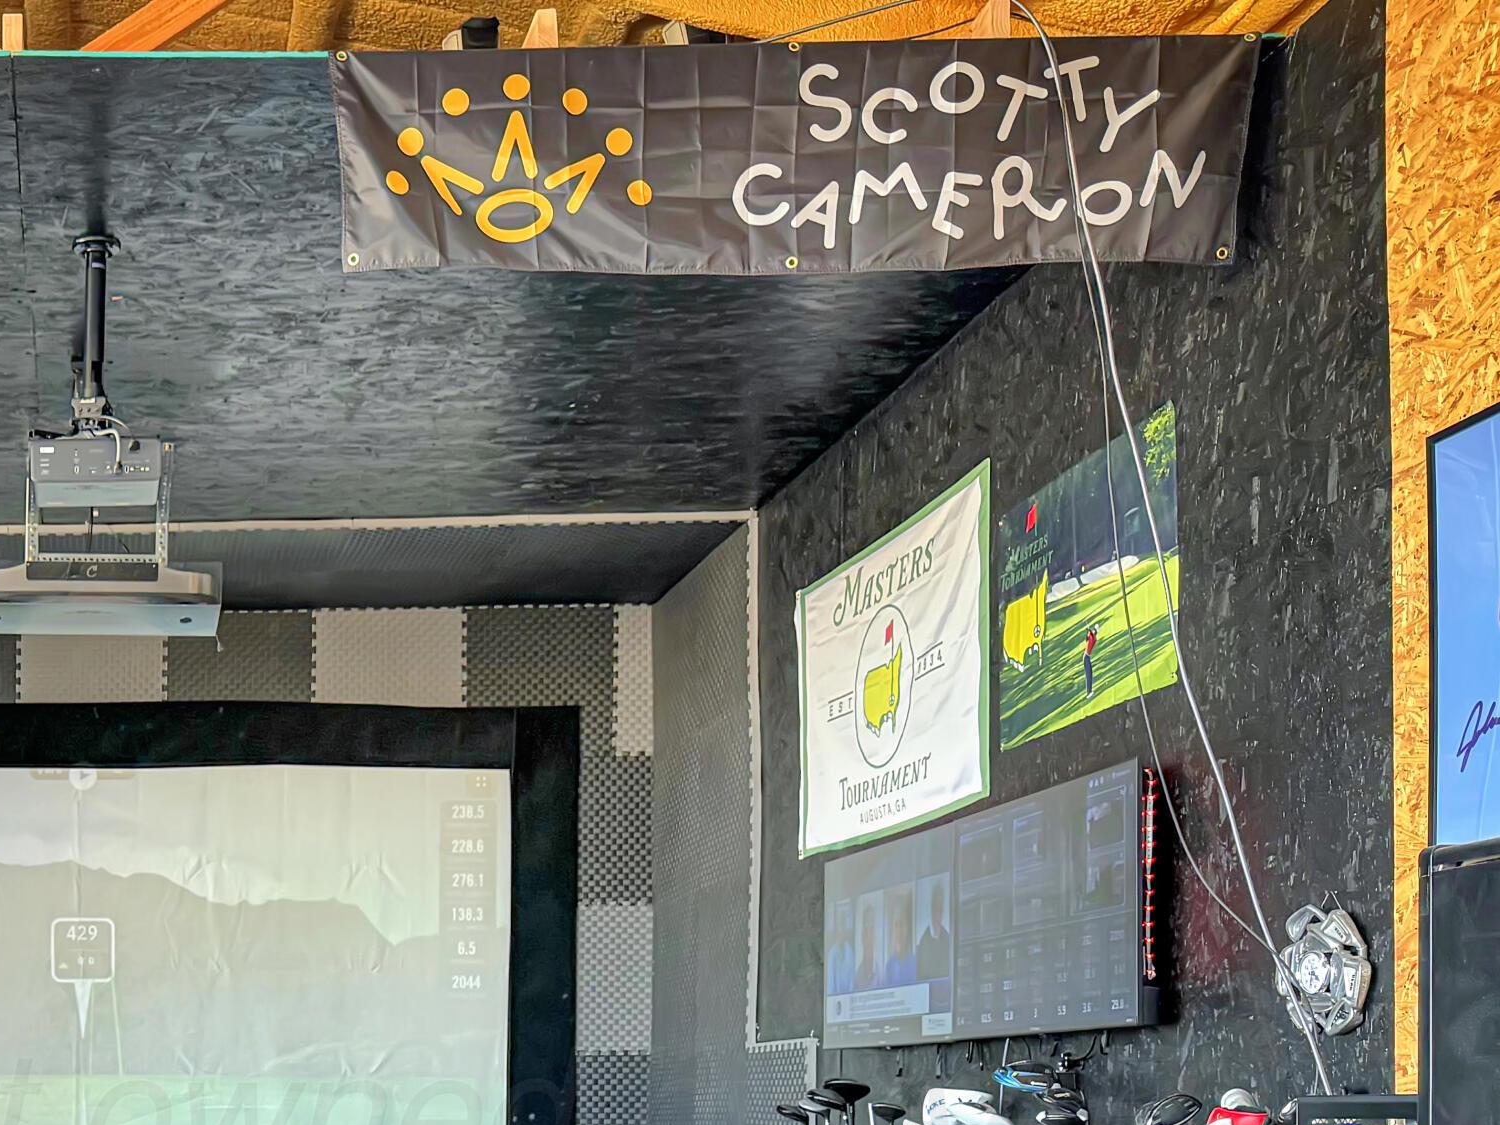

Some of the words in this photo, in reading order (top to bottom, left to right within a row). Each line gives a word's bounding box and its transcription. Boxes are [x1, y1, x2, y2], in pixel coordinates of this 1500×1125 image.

[798, 55, 1161, 153] SCOTTY
[732, 149, 1207, 251] CAMERON
[829, 697, 853, 717] EST
[66, 925, 98, 941] 429
[457, 941, 476, 955] 6.5
[451, 975, 481, 989] 2044
